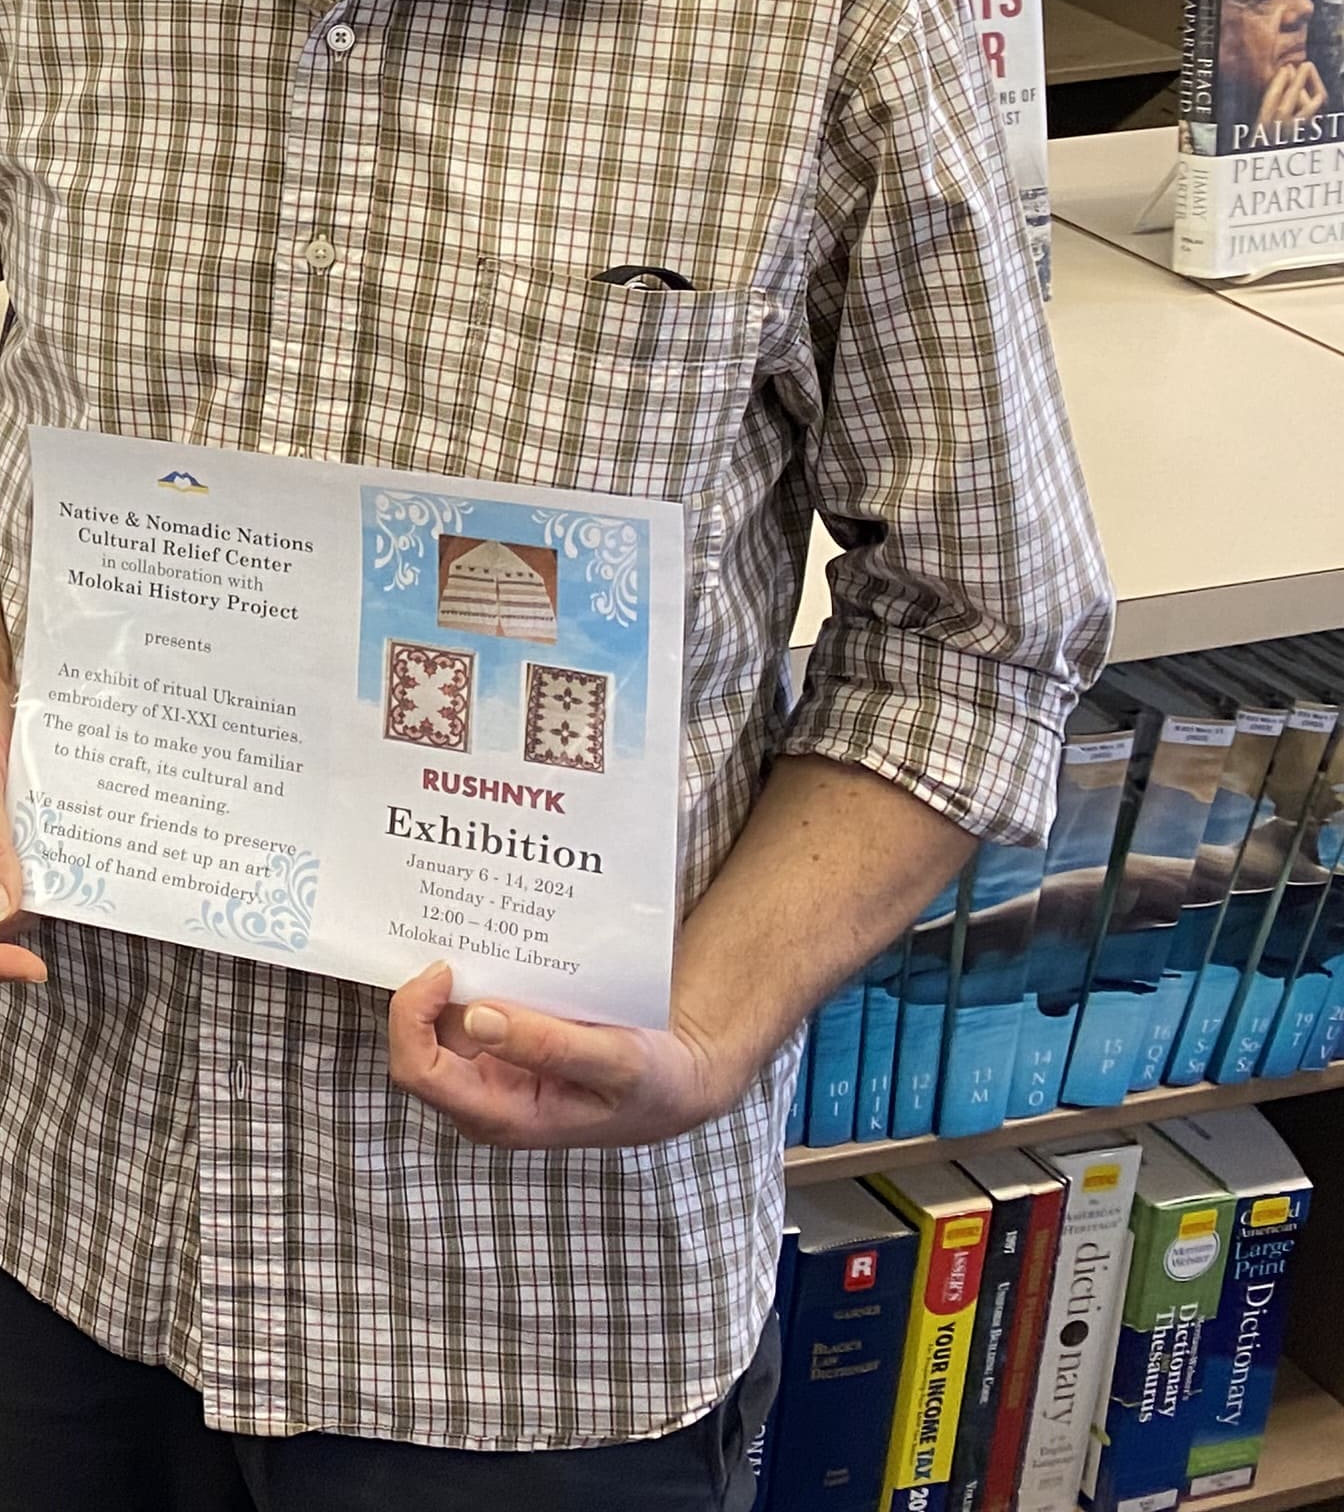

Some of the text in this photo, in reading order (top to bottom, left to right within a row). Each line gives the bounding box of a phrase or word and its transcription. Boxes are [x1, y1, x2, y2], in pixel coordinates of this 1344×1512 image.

[1234, 150, 1322, 183] PEACE
[1230, 228, 1302, 257] JIMMY
[59, 502, 313, 552] Native & Nomadic Nations
[78, 527, 292, 573] Cultural Relief Center
[68, 570, 299, 619] Molokai History Project
[102, 554, 263, 591] in collaboration with
[145, 633, 211, 652] presents
[58, 663, 296, 716] An exhibit of ritual Ukrainian
[48, 689, 302, 744] embroidery of XI-XXI centuries.
[43, 713, 303, 773] The goal is to make you familiar
[54, 743, 284, 797] to this craft, its cultural and
[423, 768, 566, 814] RUSHNYK
[97, 778, 230, 814] sacred meaning.
[27, 790, 297, 857] We assist our friends to preserve
[385, 805, 604, 874] Exhibition
[43, 821, 271, 878] traditions and set up an art
[42, 846, 262, 905] school of hand embroidery.
[406, 854, 574, 898] January 6 14, 2024
[420, 880, 556, 921] Monday Friday
[388, 921, 581, 975] Molokai Public Library
[422, 906, 549, 943] 12:00 4:00 pm
[1234, 1240, 1295, 1261] Large
[1234, 1258, 1286, 1280] Print
[1139, 1305, 1176, 1423] Thesaurus
[1158, 1303, 1199, 1417] Dictionary
[1216, 1281, 1274, 1425] Dictionary
[914, 1322, 956, 1481] YOUR INCOME TAX
